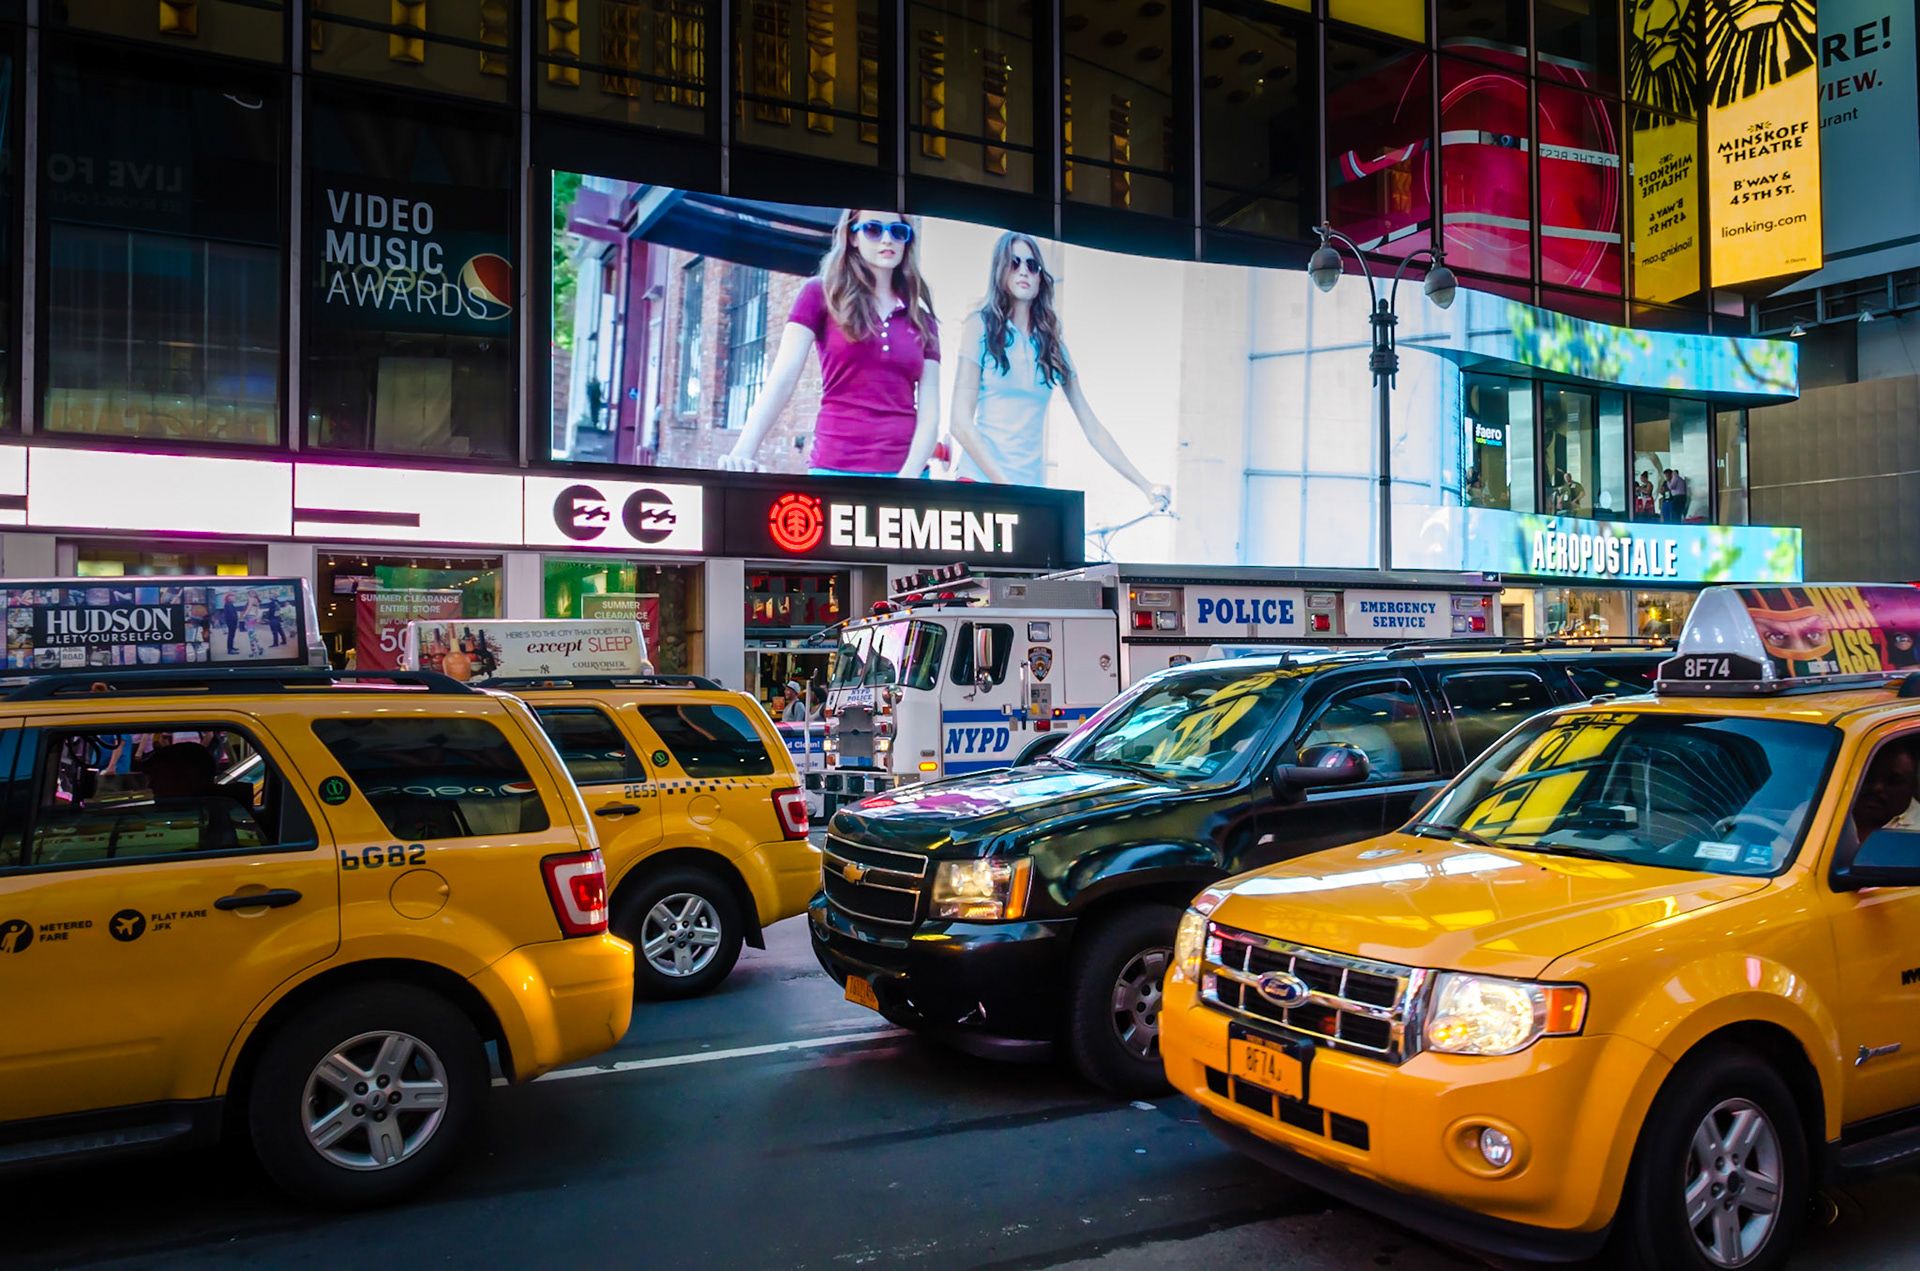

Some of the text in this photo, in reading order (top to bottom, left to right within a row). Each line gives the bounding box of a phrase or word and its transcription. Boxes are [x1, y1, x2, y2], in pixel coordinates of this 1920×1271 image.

[1717, 121, 1809, 153] MINSKOFF
[1722, 136, 1803, 164] THEATRE
[1733, 171, 1791, 191] B'WAY &
[1730, 184, 1795, 205] 45TH ST.
[326, 189, 434, 235] VIDEO
[1721, 213, 1807, 238] lionking.com
[325, 229, 444, 275] MUSIC
[326, 270, 488, 319] AWARDS
[830, 504, 1019, 553] ELEMENT
[1532, 519, 1678, 577] AÉROPOSTALE
[360, 593, 460, 604] SUMMER CLEARANCE
[380, 604, 441, 613] ENTIRE STORE
[602, 601, 641, 609] SUMMER
[1360, 601, 1436, 614] EMERGENCY
[46, 607, 172, 635] HUDSON
[594, 611, 648, 620] CLEARANCE
[1197, 598, 1294, 625] POLICE
[1373, 616, 1426, 629] SERVICE
[46, 631, 174, 644] #LETYOURSELFGO
[527, 636, 633, 657] except SLEEP
[1830, 629, 1882, 674] ASS
[1684, 658, 1731, 678] 8F74
[945, 727, 1010, 754] NYPD
[39, 920, 93, 932] METERED
[151, 909, 207, 922] FLAT FARE
[39, 932, 69, 943] FARE
[151, 922, 172, 932] JFK
